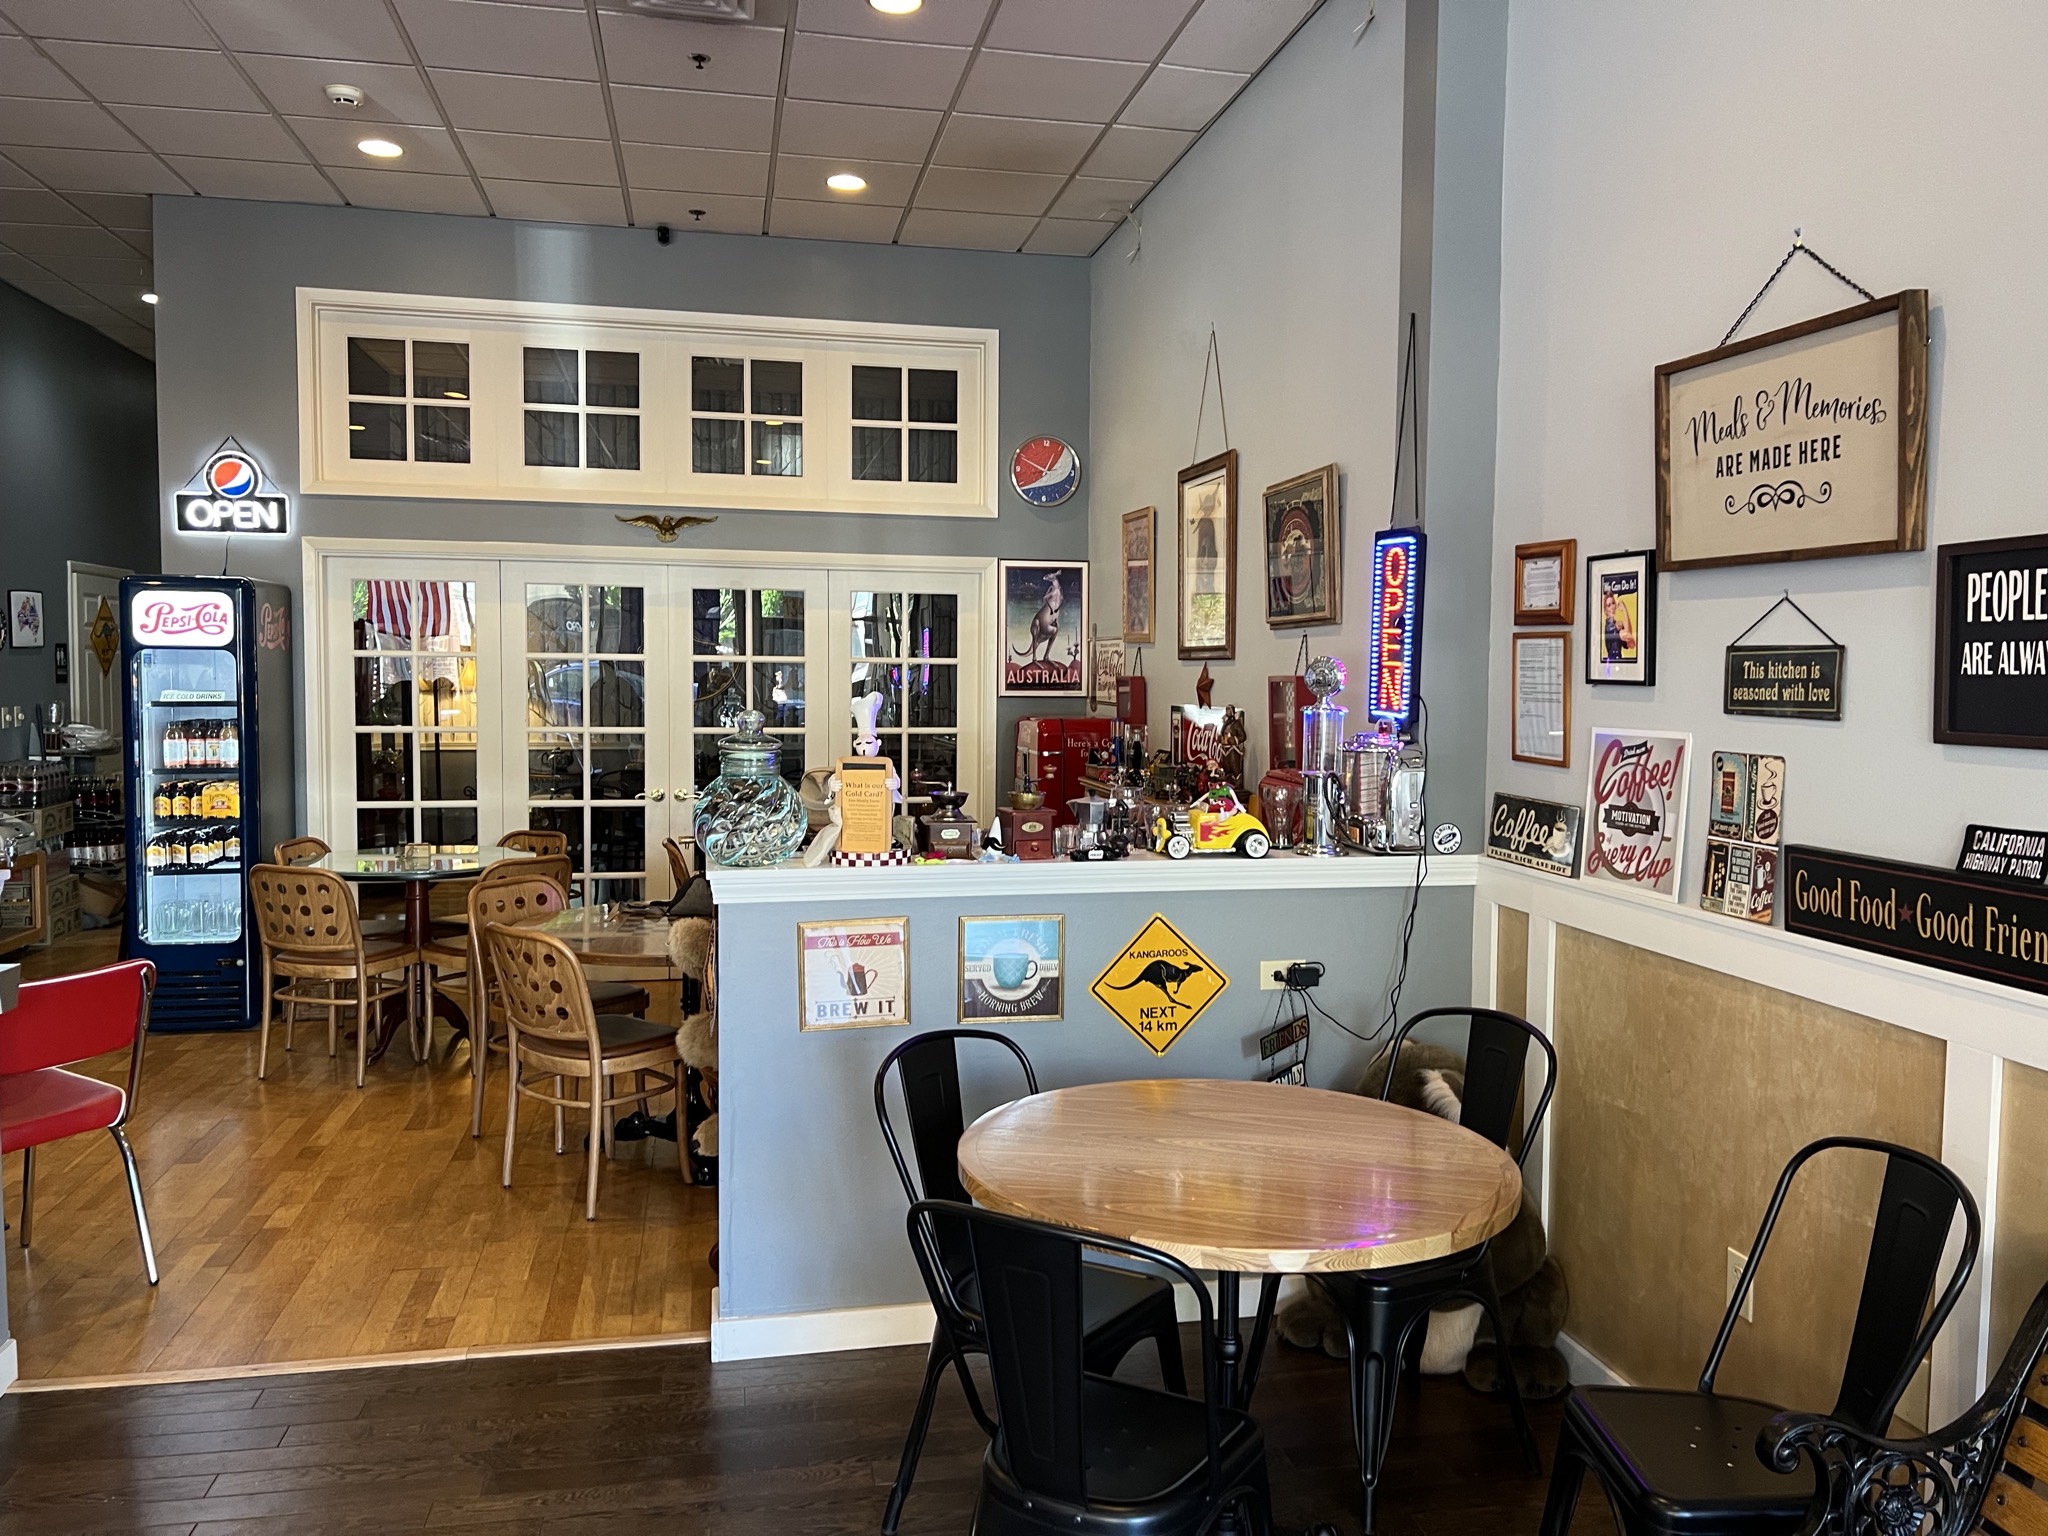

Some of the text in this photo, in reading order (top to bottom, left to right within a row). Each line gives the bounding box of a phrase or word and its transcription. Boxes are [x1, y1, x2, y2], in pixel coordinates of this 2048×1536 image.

[1685, 377, 1887, 457] Meals & Memories
[1716, 434, 1841, 478] ARE MADE HERE
[185, 498, 279, 529] OPEN
[1611, 580, 1621, 591] Can
[1621, 579, 1630, 590] Do
[1966, 567, 2048, 623] PEOPLE
[1380, 546, 1407, 710] OPEN
[1960, 640, 2048, 675] ARE ALWA
[1007, 669, 1081, 684] AUSTRALIA
[1742, 660, 1820, 679] This kitchen is
[196, 692, 222, 700] DRINKS
[1733, 682, 1830, 701] seasoned with love
[1067, 738, 1091, 748] Here's
[1594, 739, 1684, 804] Coffee!
[1494, 804, 1549, 852] Coffee
[1611, 810, 1651, 826] MOTIVATION
[1972, 830, 2046, 858] CALIFORNIA
[1550, 864, 1567, 873] HOT
[1587, 832, 1673, 888] Every Cup
[1962, 852, 2043, 879] HIGHWAY PATROL
[1795, 869, 2048, 965] Good Food Good Frien
[817, 934, 891, 948] This is How We
[1129, 949, 1188, 959] KANGAROOS
[965, 964, 991, 973] SERVED
[817, 1000, 895, 1018] BREW IT
[978, 989, 1044, 1014] MORNING BREW
[1140, 1006, 1177, 1019] NEXT
[1139, 1020, 1178, 1032] 14 km
[1263, 1020, 1308, 1056] FRIENDS
